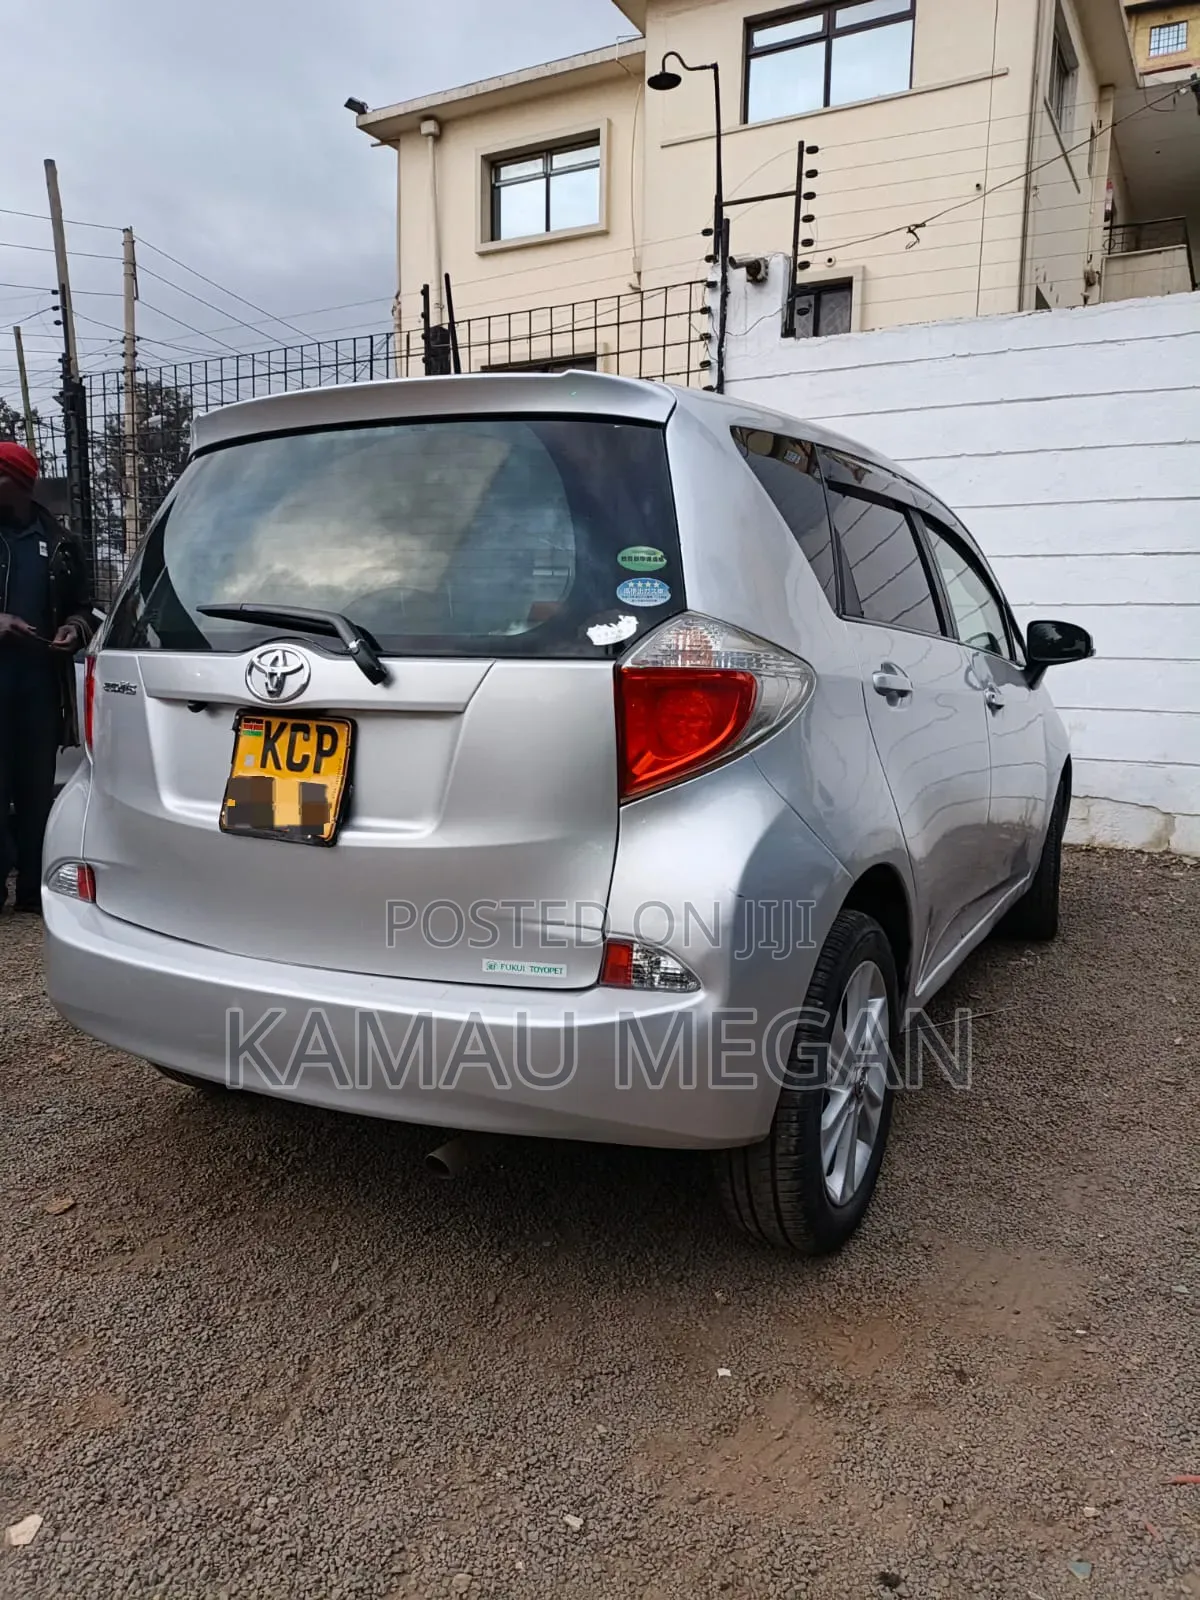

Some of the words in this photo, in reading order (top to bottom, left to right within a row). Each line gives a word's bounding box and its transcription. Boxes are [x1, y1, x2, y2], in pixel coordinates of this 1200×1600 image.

[260, 720, 339, 774] KCP
[500, 963, 526, 972] FUKUI
[529, 965, 563, 975] TOYOPET
